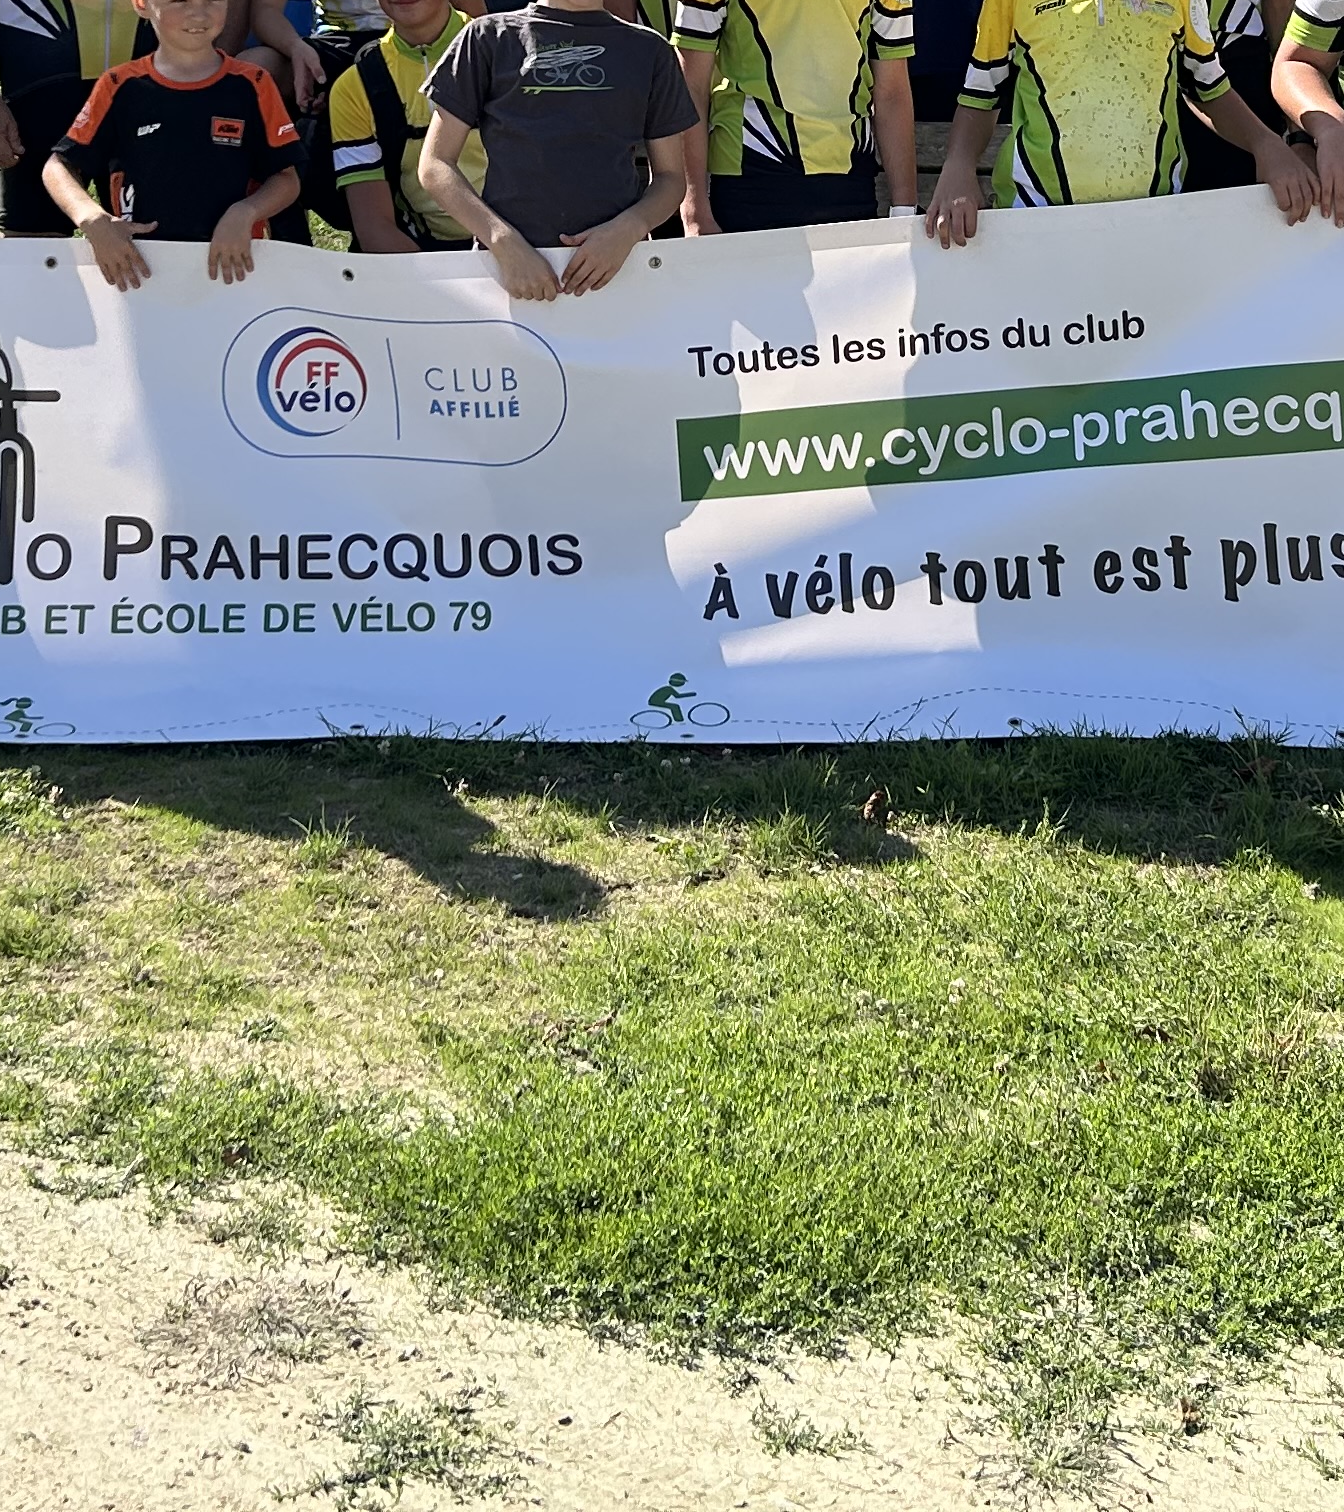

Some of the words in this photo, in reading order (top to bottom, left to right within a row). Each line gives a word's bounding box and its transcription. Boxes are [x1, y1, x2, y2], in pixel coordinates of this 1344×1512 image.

[687, 340, 820, 378] Toutes
[832, 333, 886, 365] les
[898, 322, 990, 358] infos
[1002, 317, 1051, 349] du
[1063, 309, 1145, 345] club
[307, 362, 340, 386] FF
[424, 367, 518, 392] CLUB
[275, 382, 356, 413] vélo
[429, 395, 520, 419] AFFILIÉ
[104, 515, 583, 583] PRAHECQUOIS
[702, 562, 740, 621] À
[765, 552, 895, 620] vélo
[919, 543, 1066, 606] tout
[1093, 535, 1192, 595] est
[44, 604, 94, 635] ET
[110, 596, 247, 634] ÉCOLE
[263, 603, 316, 633] DE
[332, 595, 436, 633] VÉLO
[448, 601, 492, 632] 79
